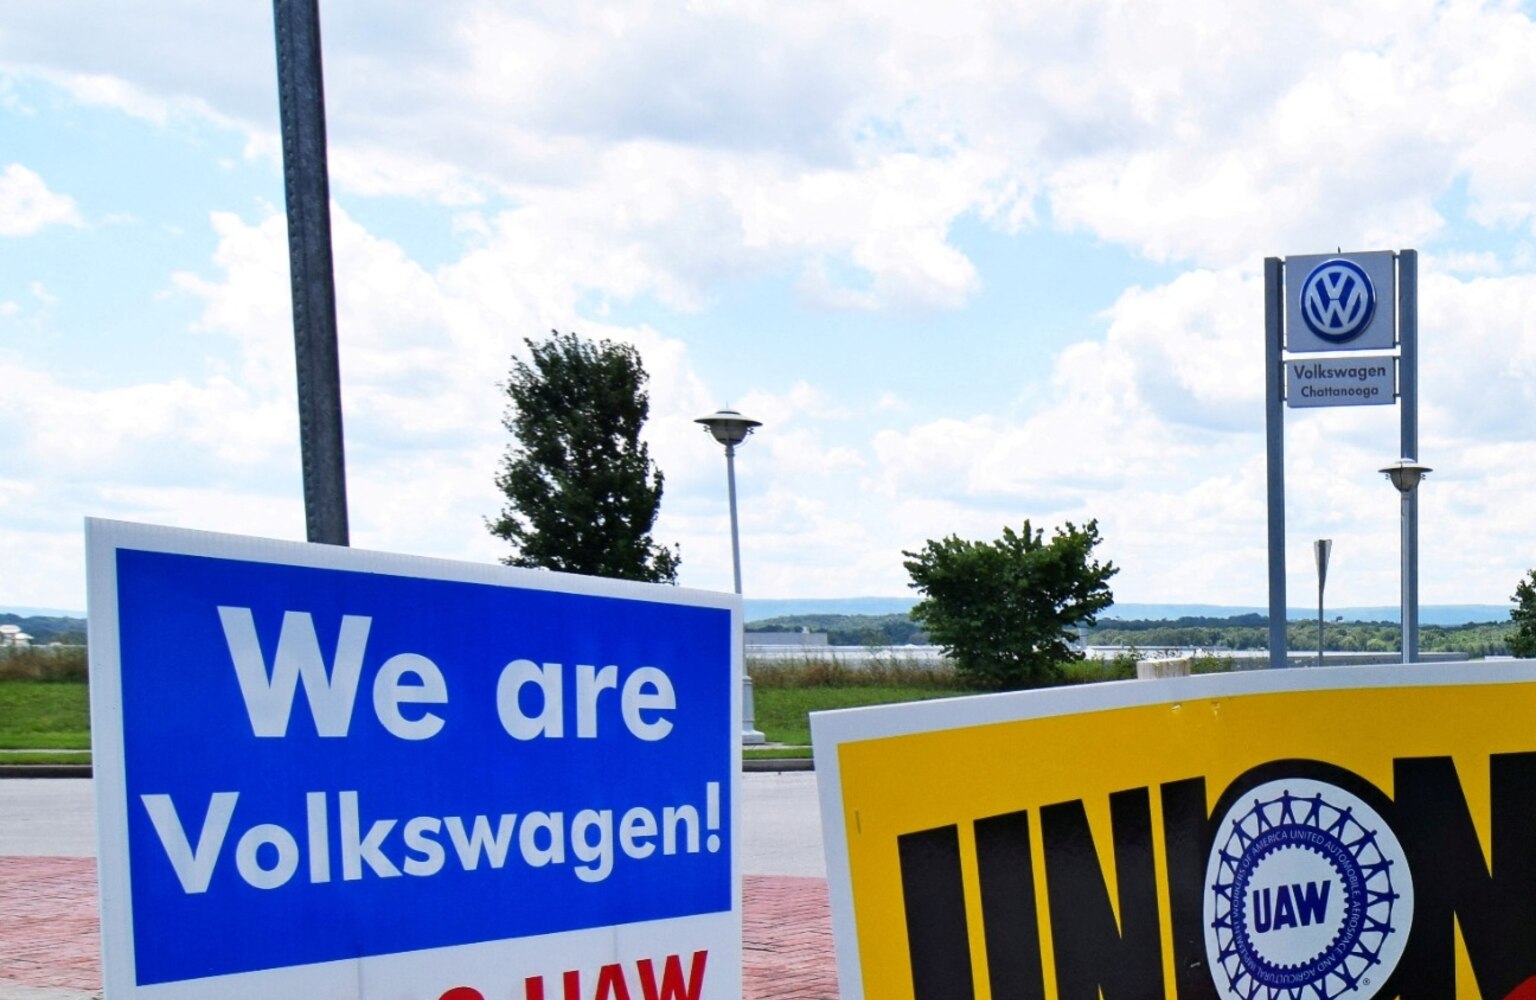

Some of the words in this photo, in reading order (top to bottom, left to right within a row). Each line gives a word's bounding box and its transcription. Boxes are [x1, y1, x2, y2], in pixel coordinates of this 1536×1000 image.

[1293, 364, 1386, 381] Volkswagen
[1301, 386, 1379, 398] Chattanooga
[217, 606, 448, 741] We
[496, 659, 677, 741] are
[140, 781, 721, 895] Volkswagen!
[1251, 830, 1288, 856] AMERICA
[1289, 829, 1325, 845] UNITED
[1242, 853, 1253, 868] OF
[1253, 880, 1331, 933] UAW
[1335, 901, 1361, 954] AEROSPACE
[1316, 953, 1336, 972] AND
